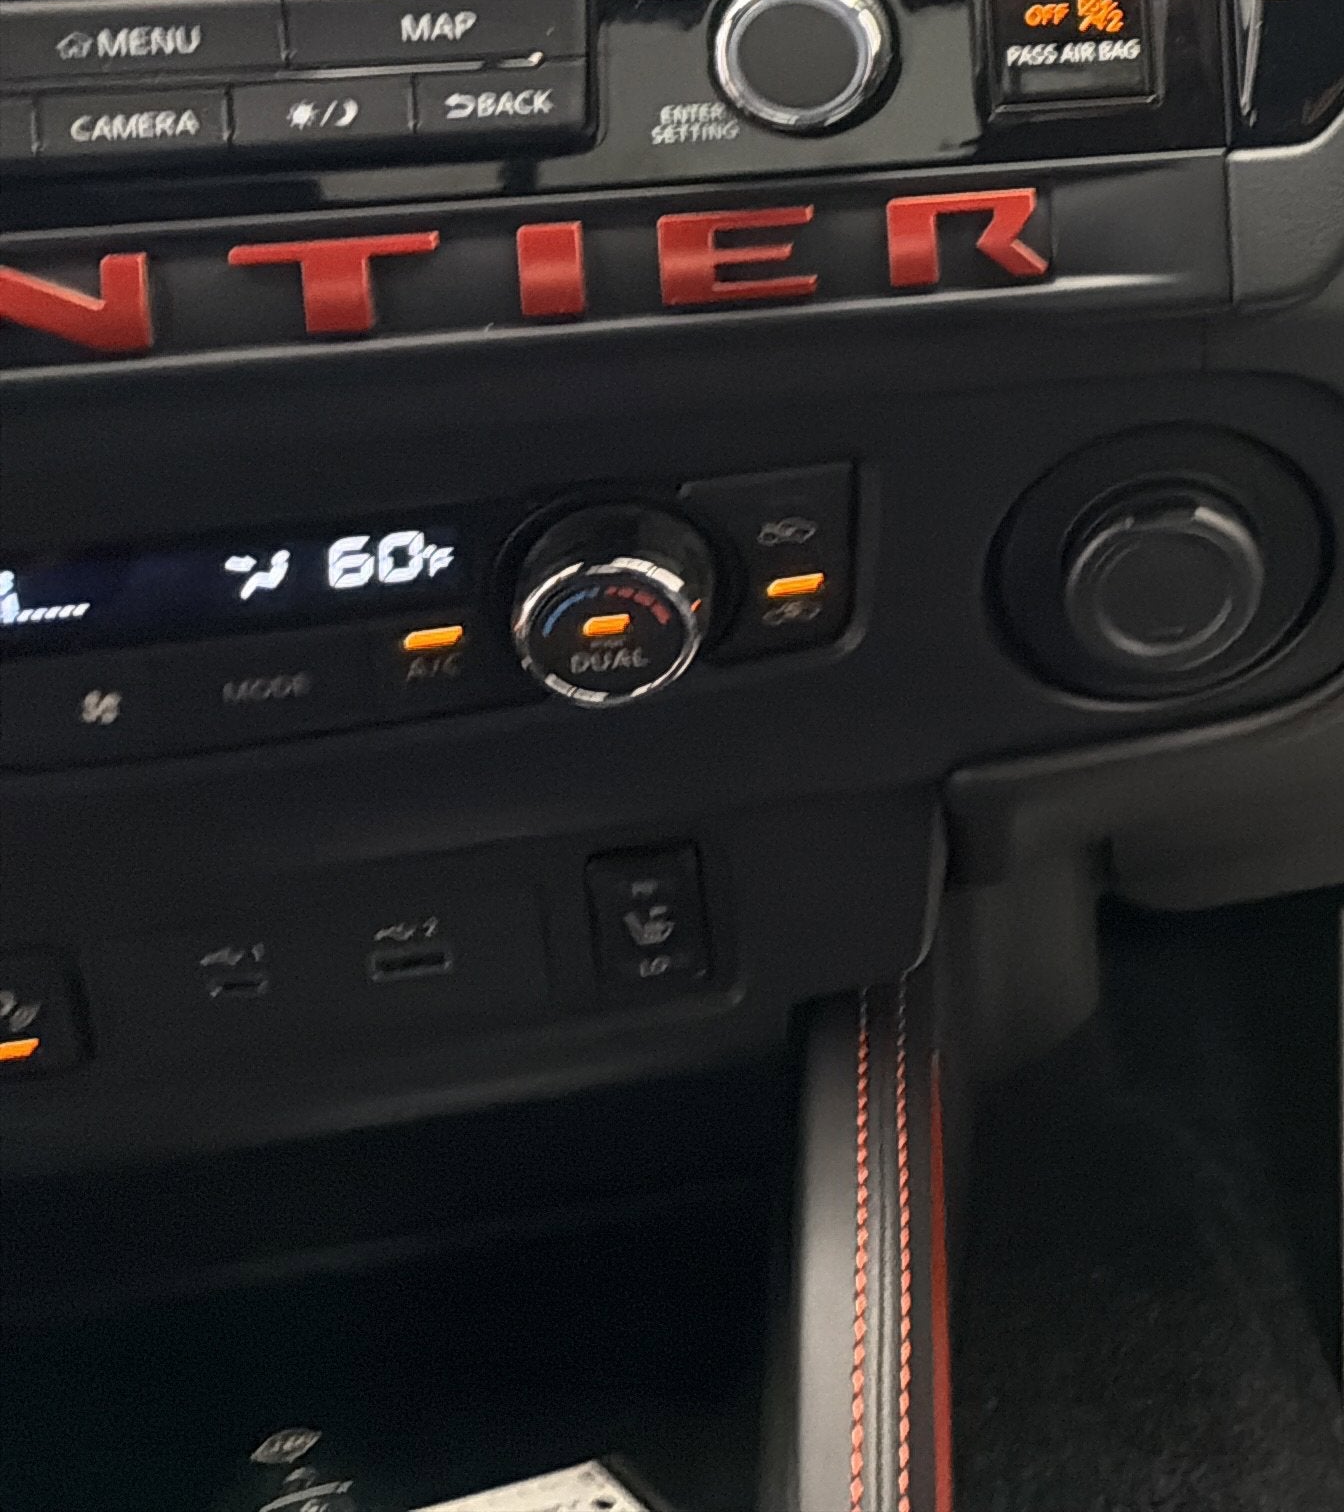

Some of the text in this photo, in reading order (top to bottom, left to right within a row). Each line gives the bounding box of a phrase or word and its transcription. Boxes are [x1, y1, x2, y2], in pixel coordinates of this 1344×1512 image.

[401, 10, 477, 42] MAP
[1025, 3, 1069, 26] OFF
[97, 24, 201, 58] MENU
[1007, 39, 1141, 66] PASS AIR BAG
[477, 89, 554, 118] BACK
[660, 102, 726, 125] ENTER
[70, 109, 200, 142] CAMERA
[651, 119, 740, 145] SETTING
[570, 646, 649, 674] DUAL
[222, 671, 311, 703] MODE
